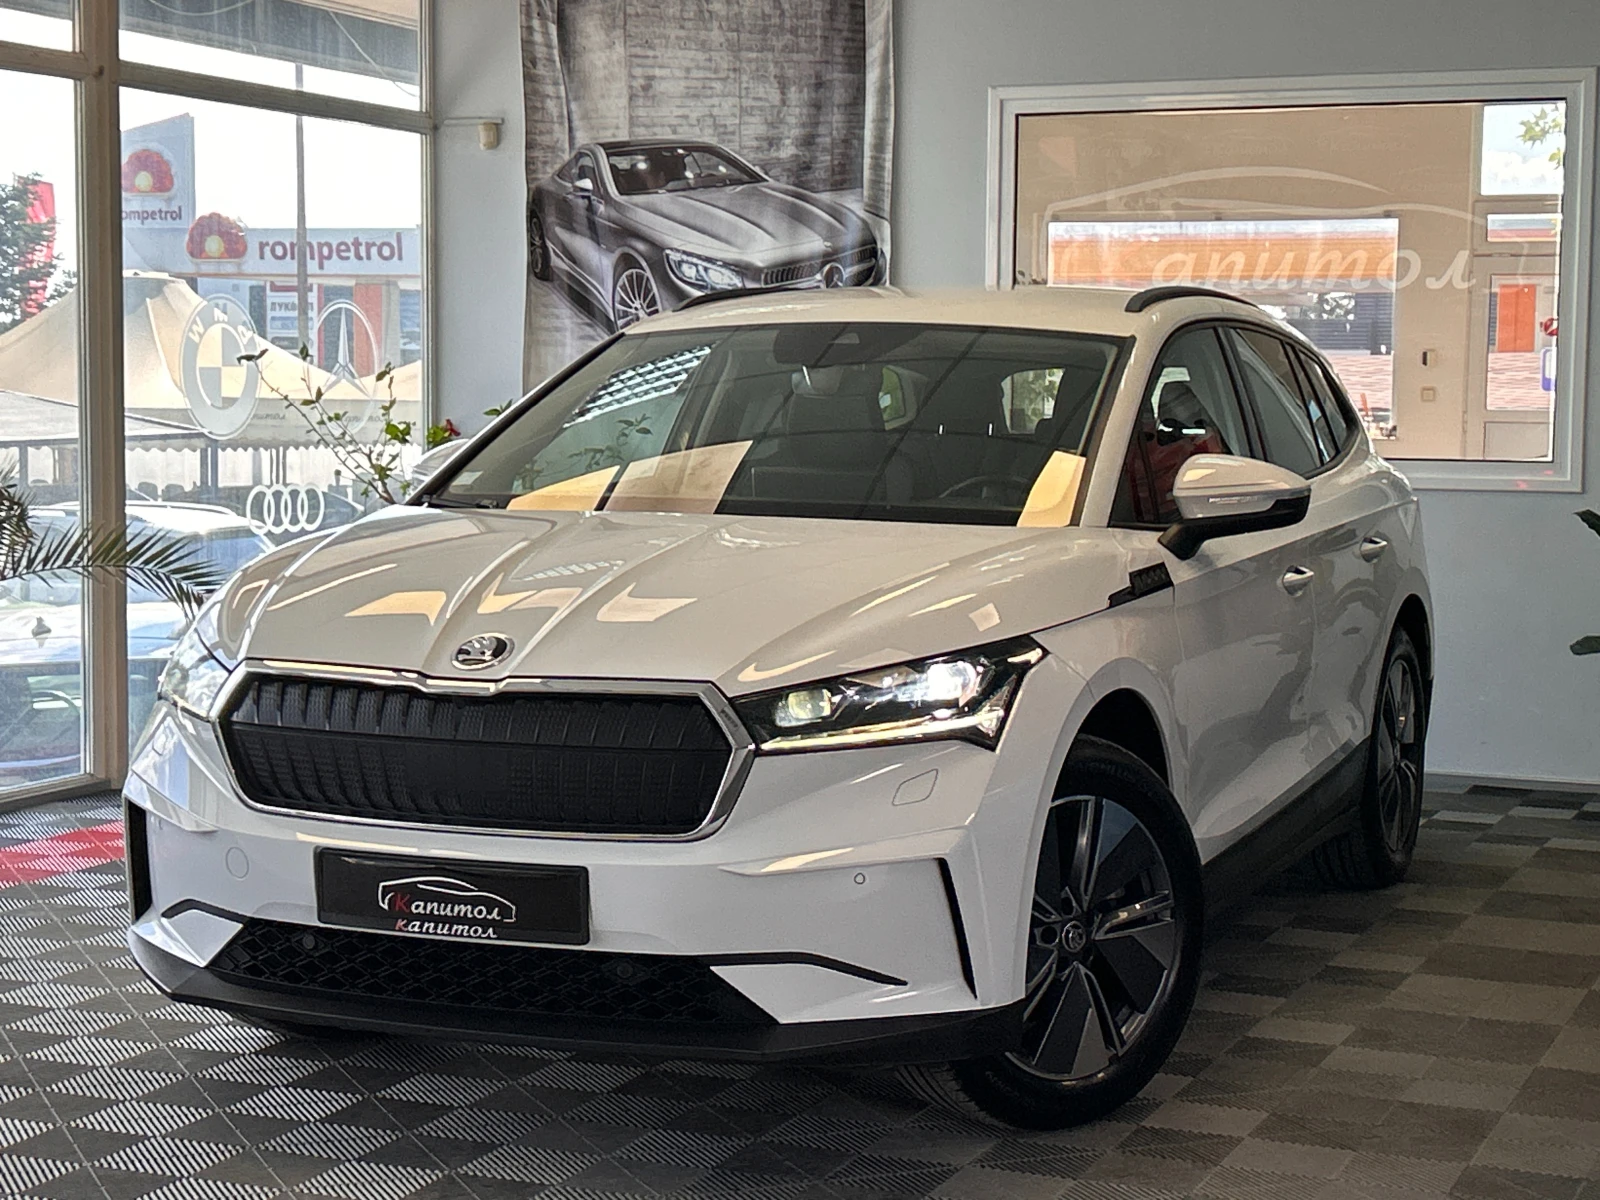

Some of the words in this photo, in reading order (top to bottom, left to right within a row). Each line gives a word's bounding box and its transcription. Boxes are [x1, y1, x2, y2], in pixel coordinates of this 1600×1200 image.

[122, 205, 182, 226] ompetrol
[259, 232, 403, 270] rompetrol
[270, 301, 314, 312] ЛУКОЛ
[395, 892, 502, 919] Капитол
